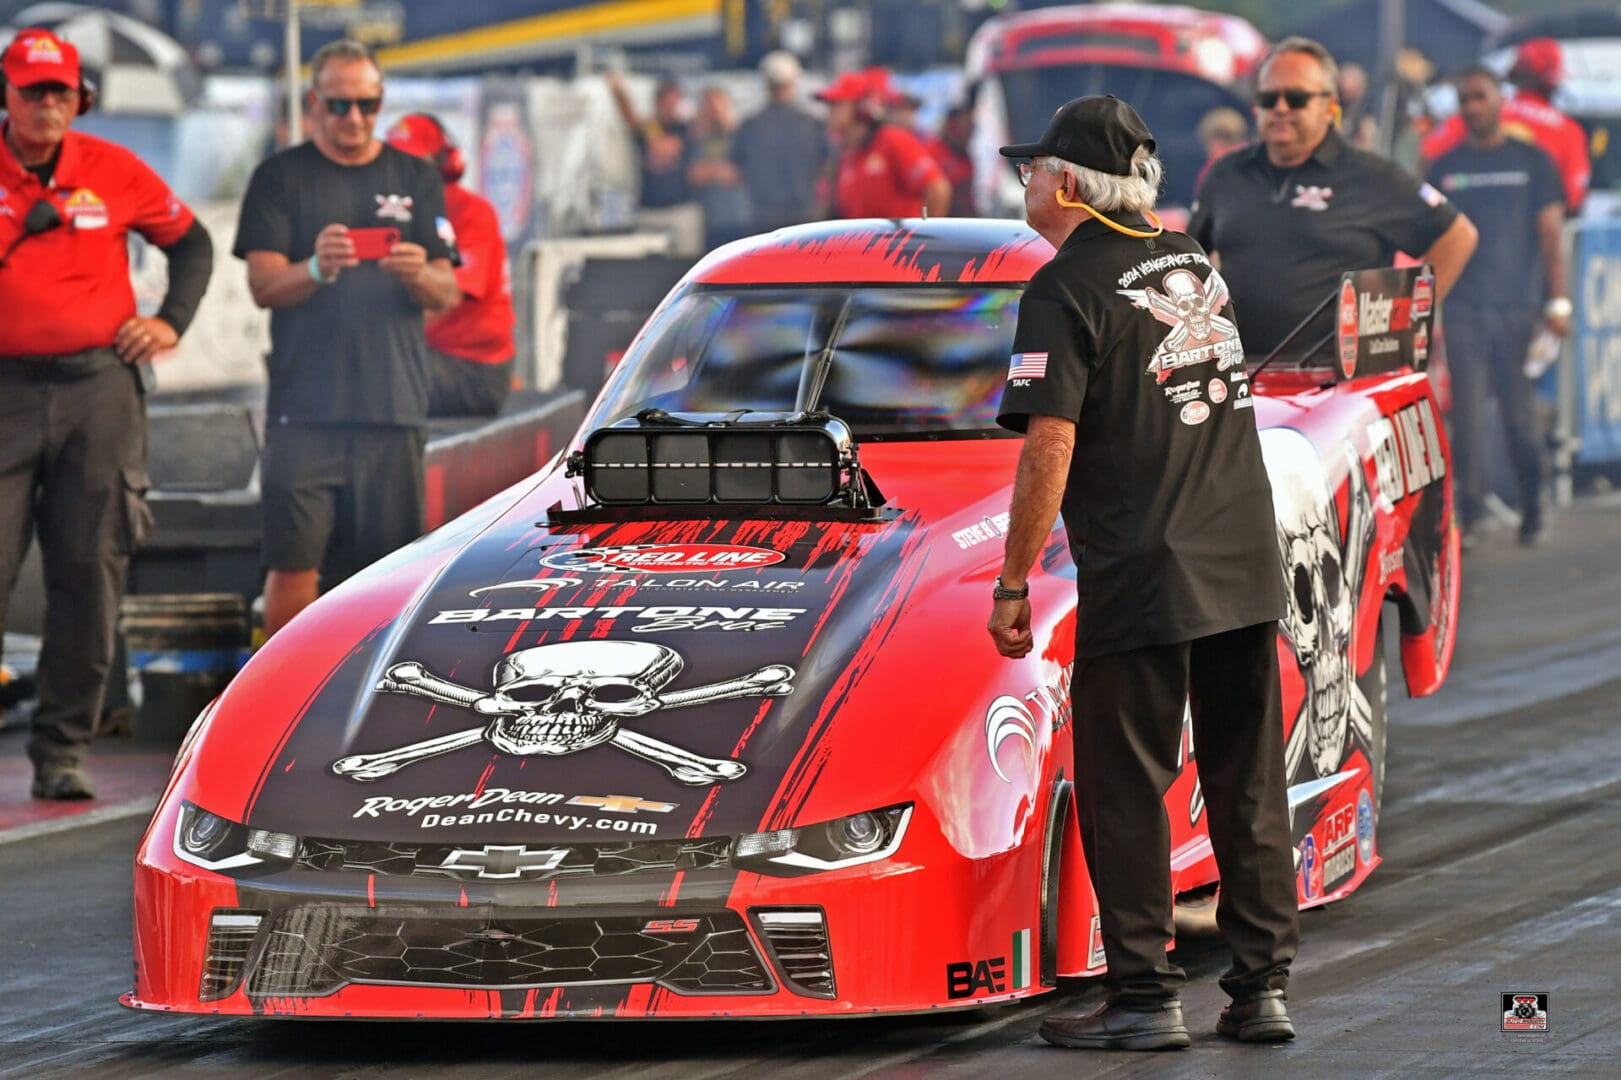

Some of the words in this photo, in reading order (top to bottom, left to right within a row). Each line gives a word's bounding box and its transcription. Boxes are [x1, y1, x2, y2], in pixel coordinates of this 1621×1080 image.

[1012, 379, 1032, 387] TAFC
[952, 523, 989, 550] STEVE
[609, 552, 685, 563] RED
[685, 552, 773, 564] LINE
[596, 578, 729, 588] TALON
[732, 580, 805, 590] AIR
[427, 606, 807, 625] BARTONE
[353, 793, 480, 818] Roger
[468, 788, 565, 809] Dean
[421, 808, 658, 836] DeanChevy.com
[641, 918, 701, 934] SS
[947, 956, 1006, 1000] BAE
